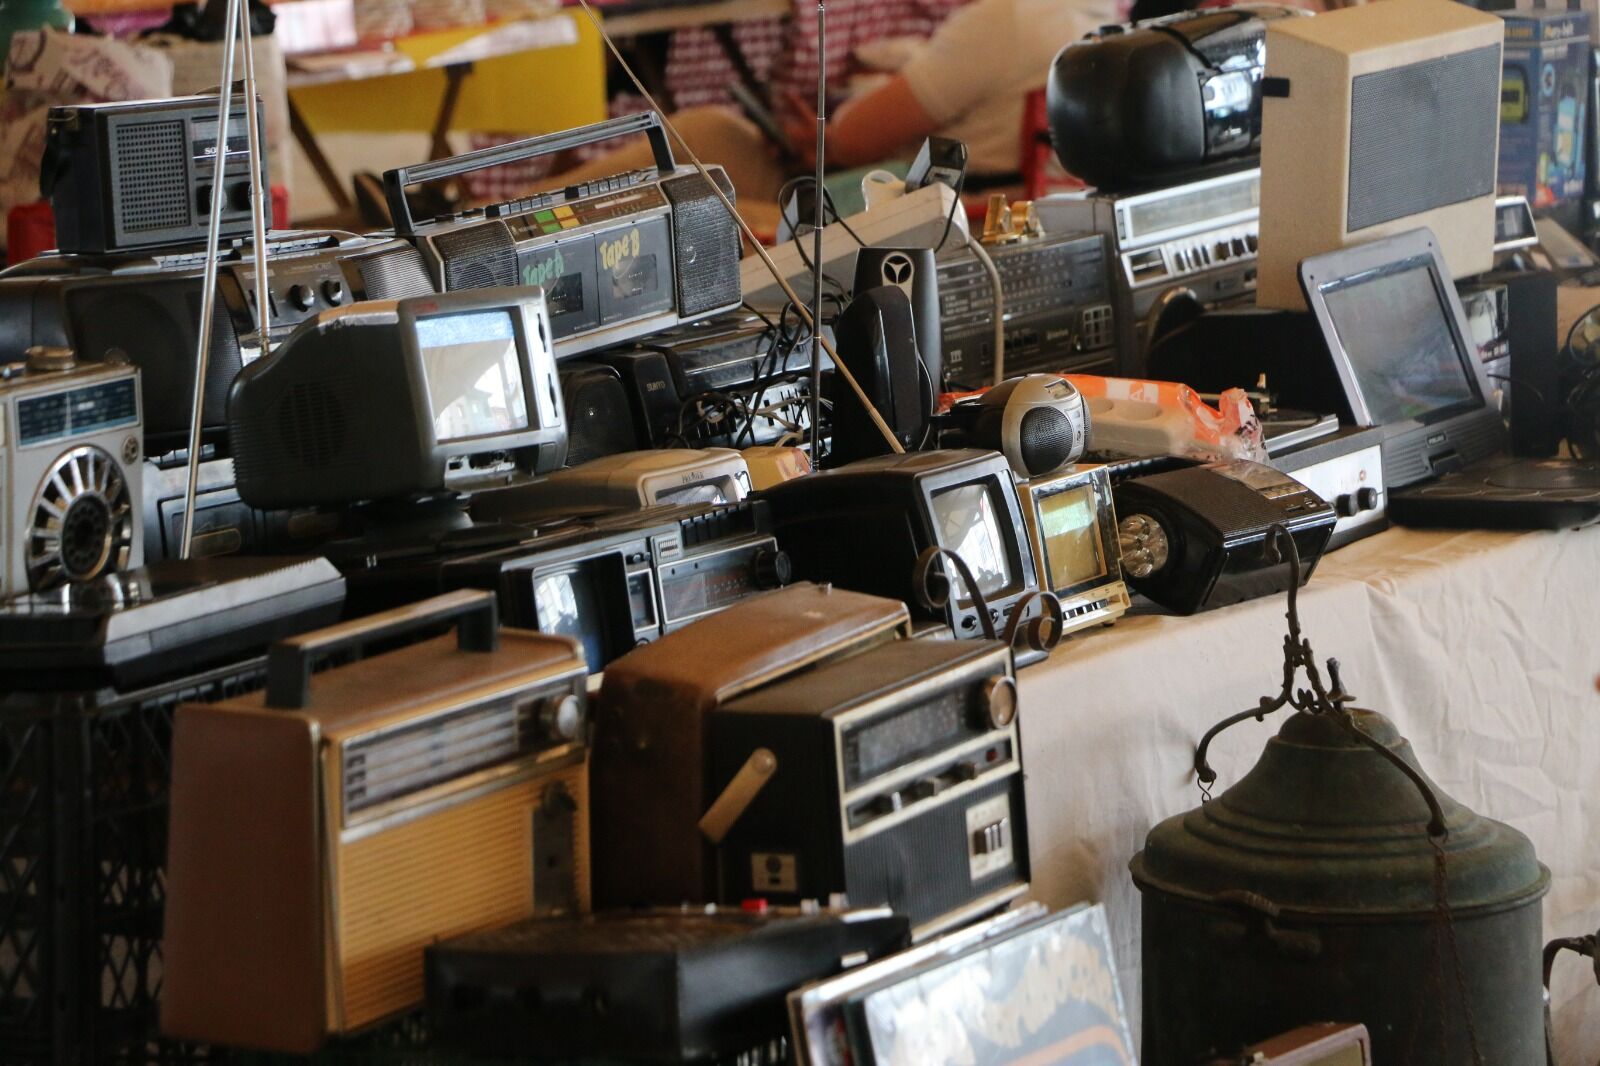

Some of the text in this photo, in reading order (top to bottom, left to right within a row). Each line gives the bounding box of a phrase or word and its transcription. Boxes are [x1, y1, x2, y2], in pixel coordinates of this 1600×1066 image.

[204, 145, 232, 155] SOL
[522, 249, 565, 286] Tape A
[600, 227, 640, 271] Tape B
